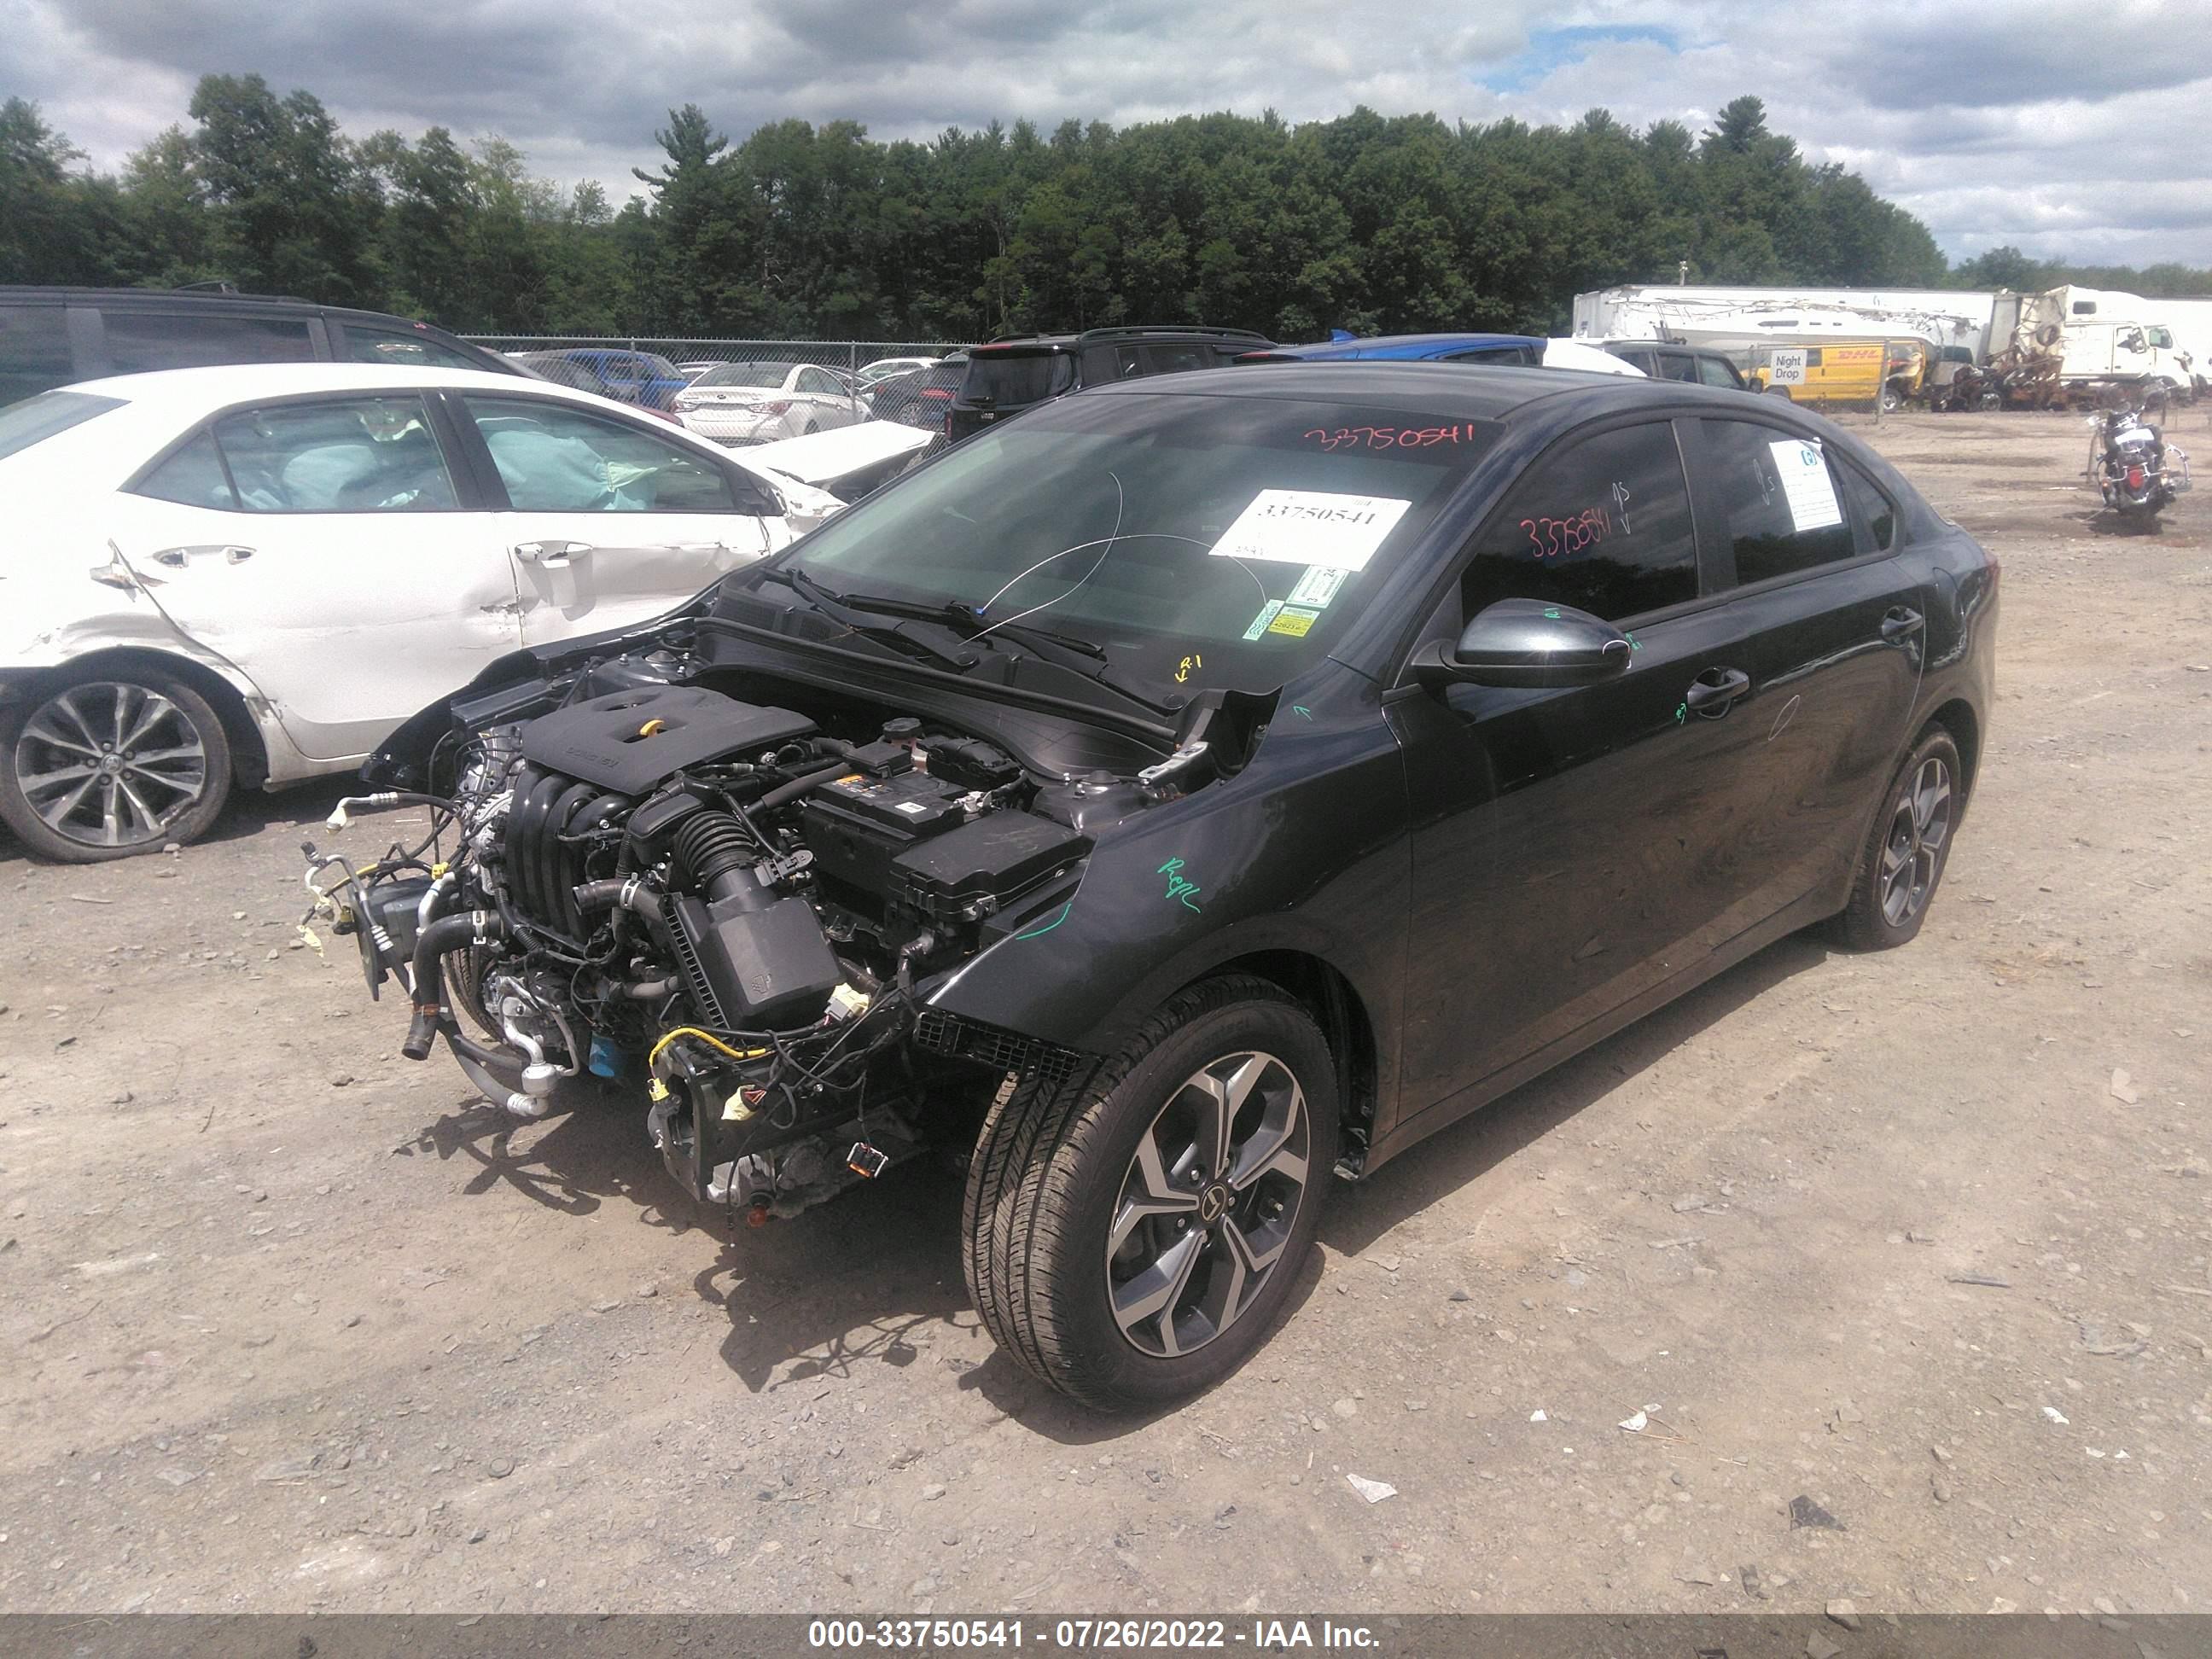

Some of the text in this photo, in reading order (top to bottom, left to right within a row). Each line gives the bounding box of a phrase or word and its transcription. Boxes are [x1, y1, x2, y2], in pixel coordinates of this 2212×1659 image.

[1837, 349, 1879, 359] DHL
[1776, 356, 1802, 369] Night
[1775, 369, 1800, 381] Drop
[1304, 424, 1476, 451] 33750541
[1257, 504, 1377, 525] 33750541
